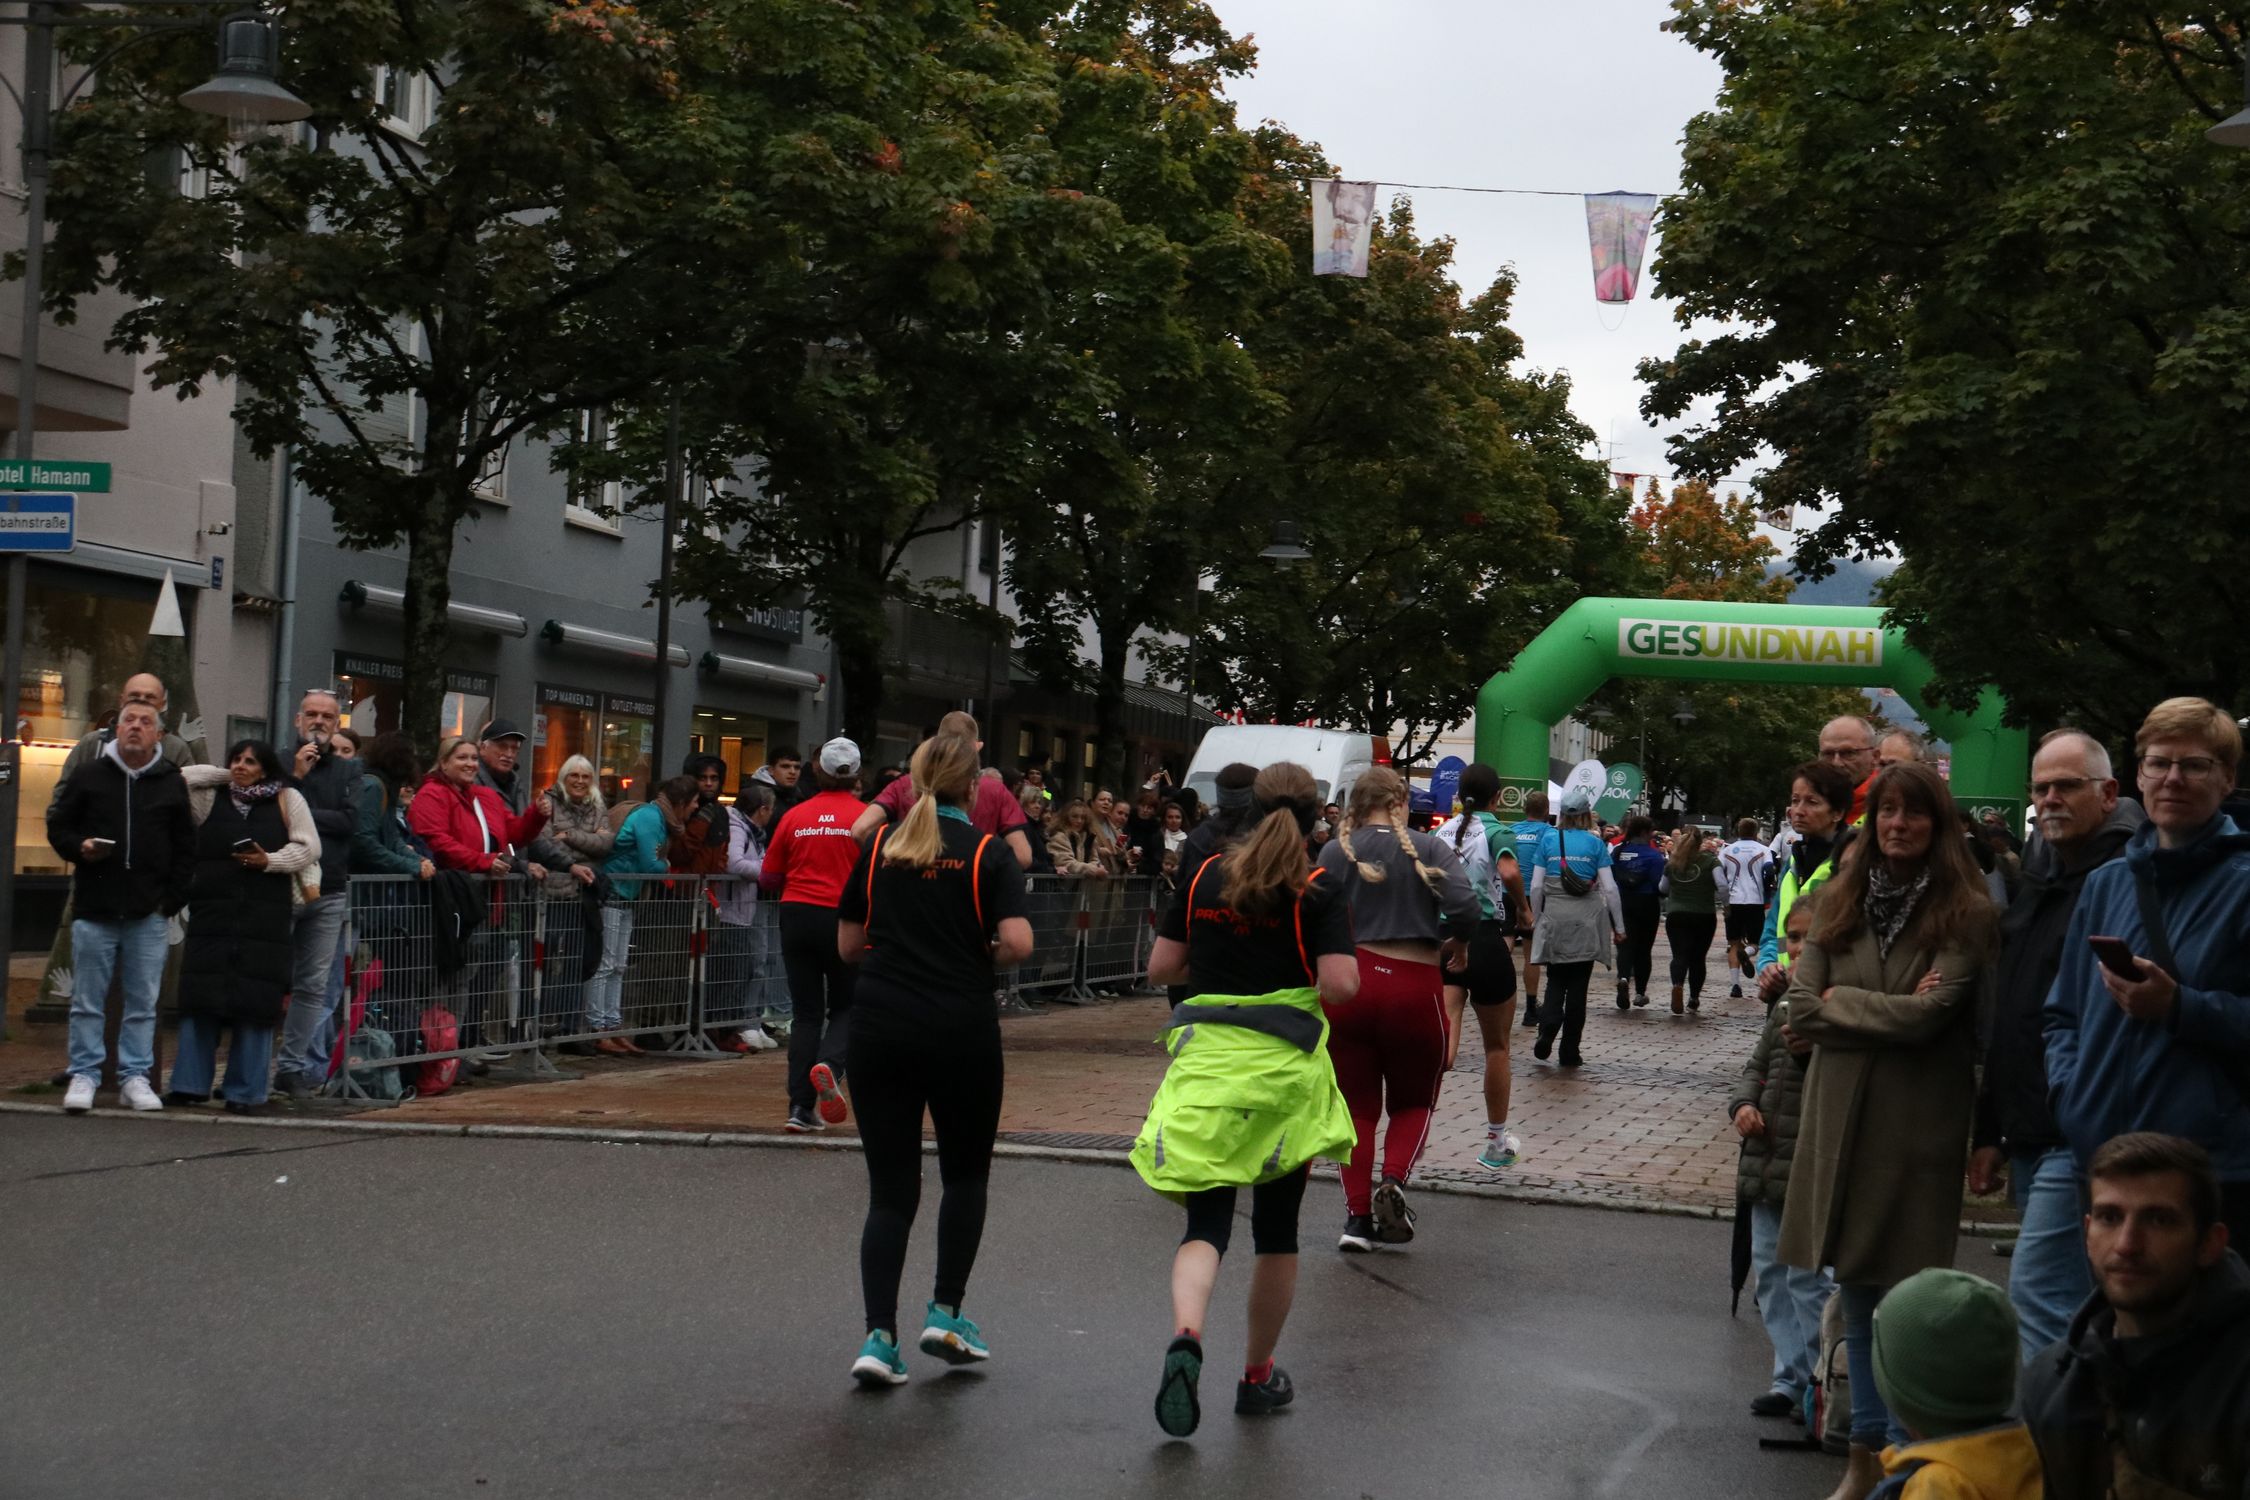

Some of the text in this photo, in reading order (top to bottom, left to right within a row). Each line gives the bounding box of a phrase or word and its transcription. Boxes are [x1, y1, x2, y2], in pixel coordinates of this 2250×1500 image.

[31, 466, 91, 485] Hamann
[0, 516, 67, 529] bahnstraße
[1627, 623, 1875, 663] GESUNDNAH
[345, 659, 404, 680] KNALLER PREIS
[545, 689, 595, 707] TOP MARKEN ZU
[1602, 787, 1632, 800] AOK
[818, 814, 835, 823] AXA
[794, 826, 824, 838] Ostdorf
